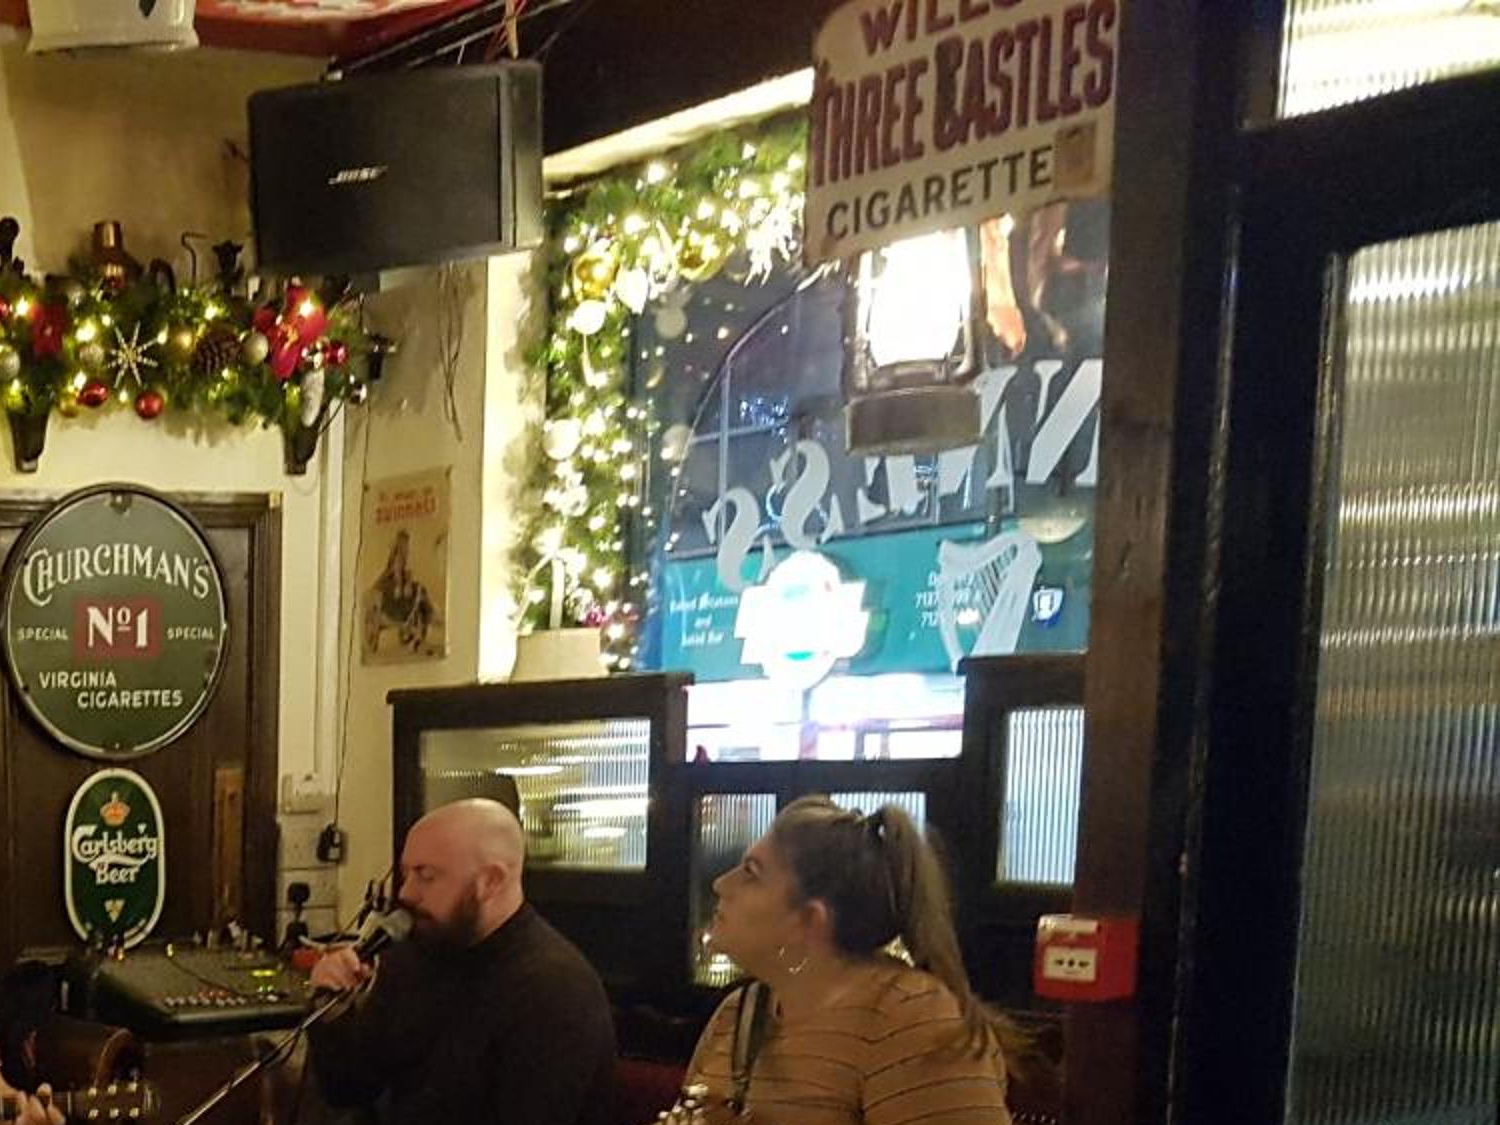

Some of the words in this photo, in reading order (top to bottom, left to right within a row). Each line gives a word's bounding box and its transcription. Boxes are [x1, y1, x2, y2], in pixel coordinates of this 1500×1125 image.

[809, 58, 928, 188] THREE
[933, 0, 1116, 151] CASTLES
[23, 543, 210, 607] CHURCHMAN'S
[17, 627, 68, 641] SPECIAL
[166, 627, 215, 641] SPECIAL
[39, 670, 118, 688] VIRGINIA
[77, 689, 184, 709] CIGARETTES
[72, 824, 158, 864] Carlsberg
[95, 863, 140, 885] Beer
